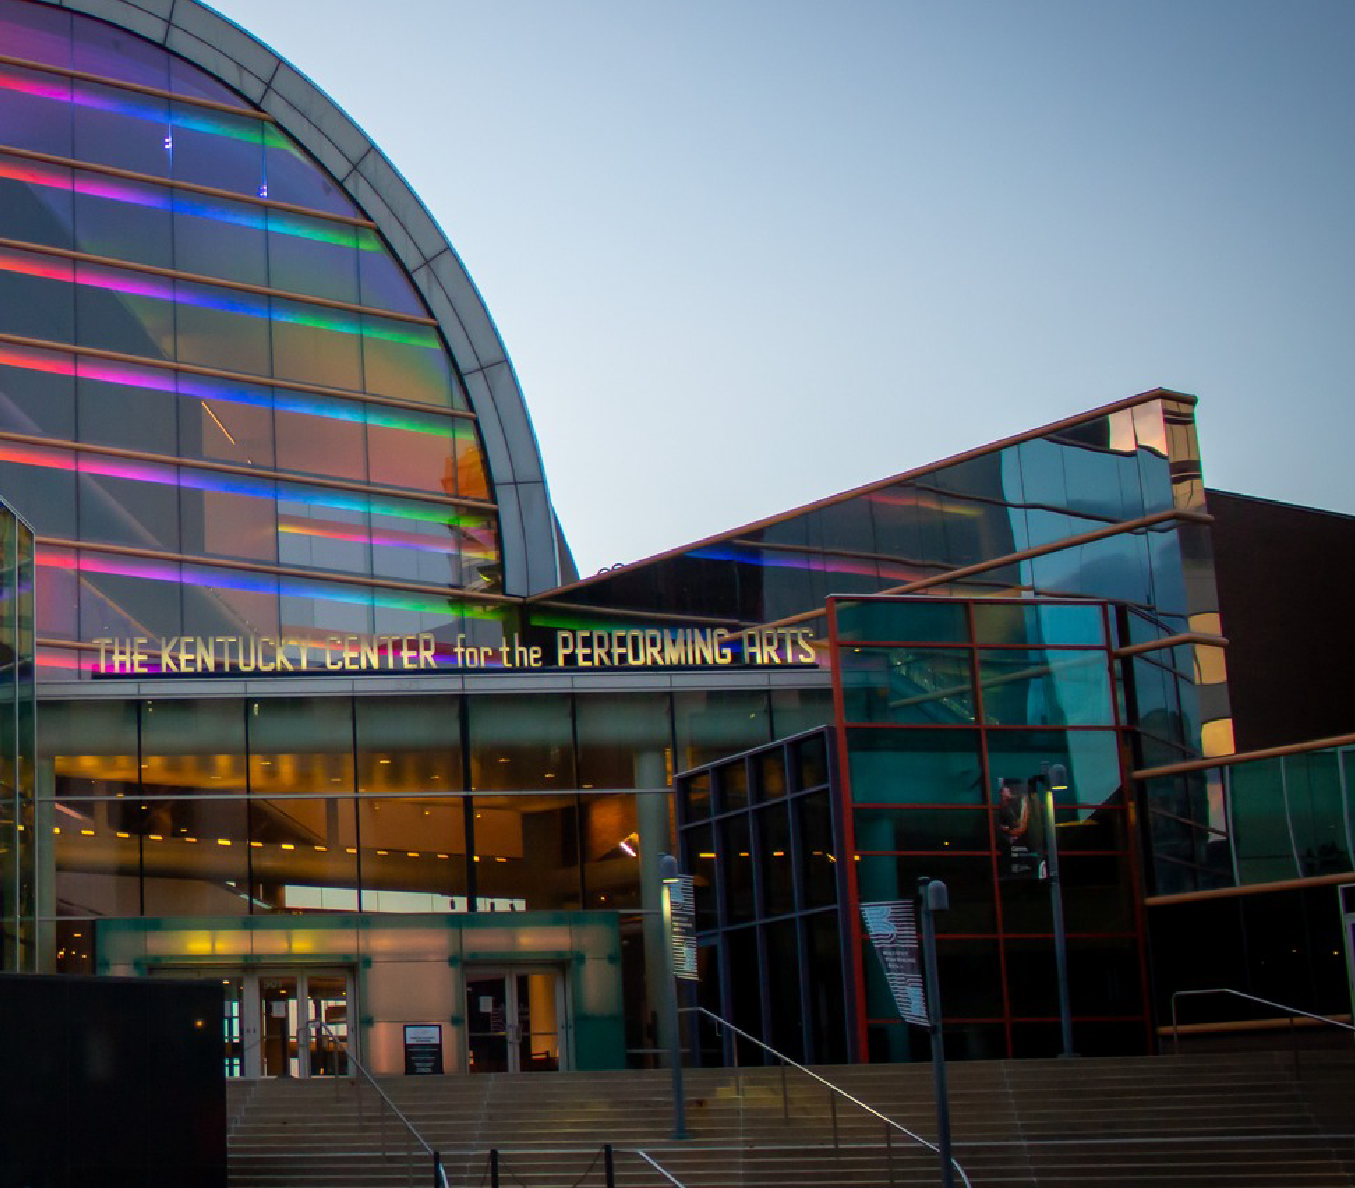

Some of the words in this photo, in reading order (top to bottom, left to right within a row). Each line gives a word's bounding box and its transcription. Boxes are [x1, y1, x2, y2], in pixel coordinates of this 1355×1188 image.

[92, 636, 148, 673] THE
[161, 634, 309, 672] KENTUCKY
[326, 633, 438, 670] CENTER
[453, 633, 493, 668] for
[499, 632, 543, 668] the
[557, 629, 732, 667] PERFORMING
[744, 628, 816, 665] ARTS
